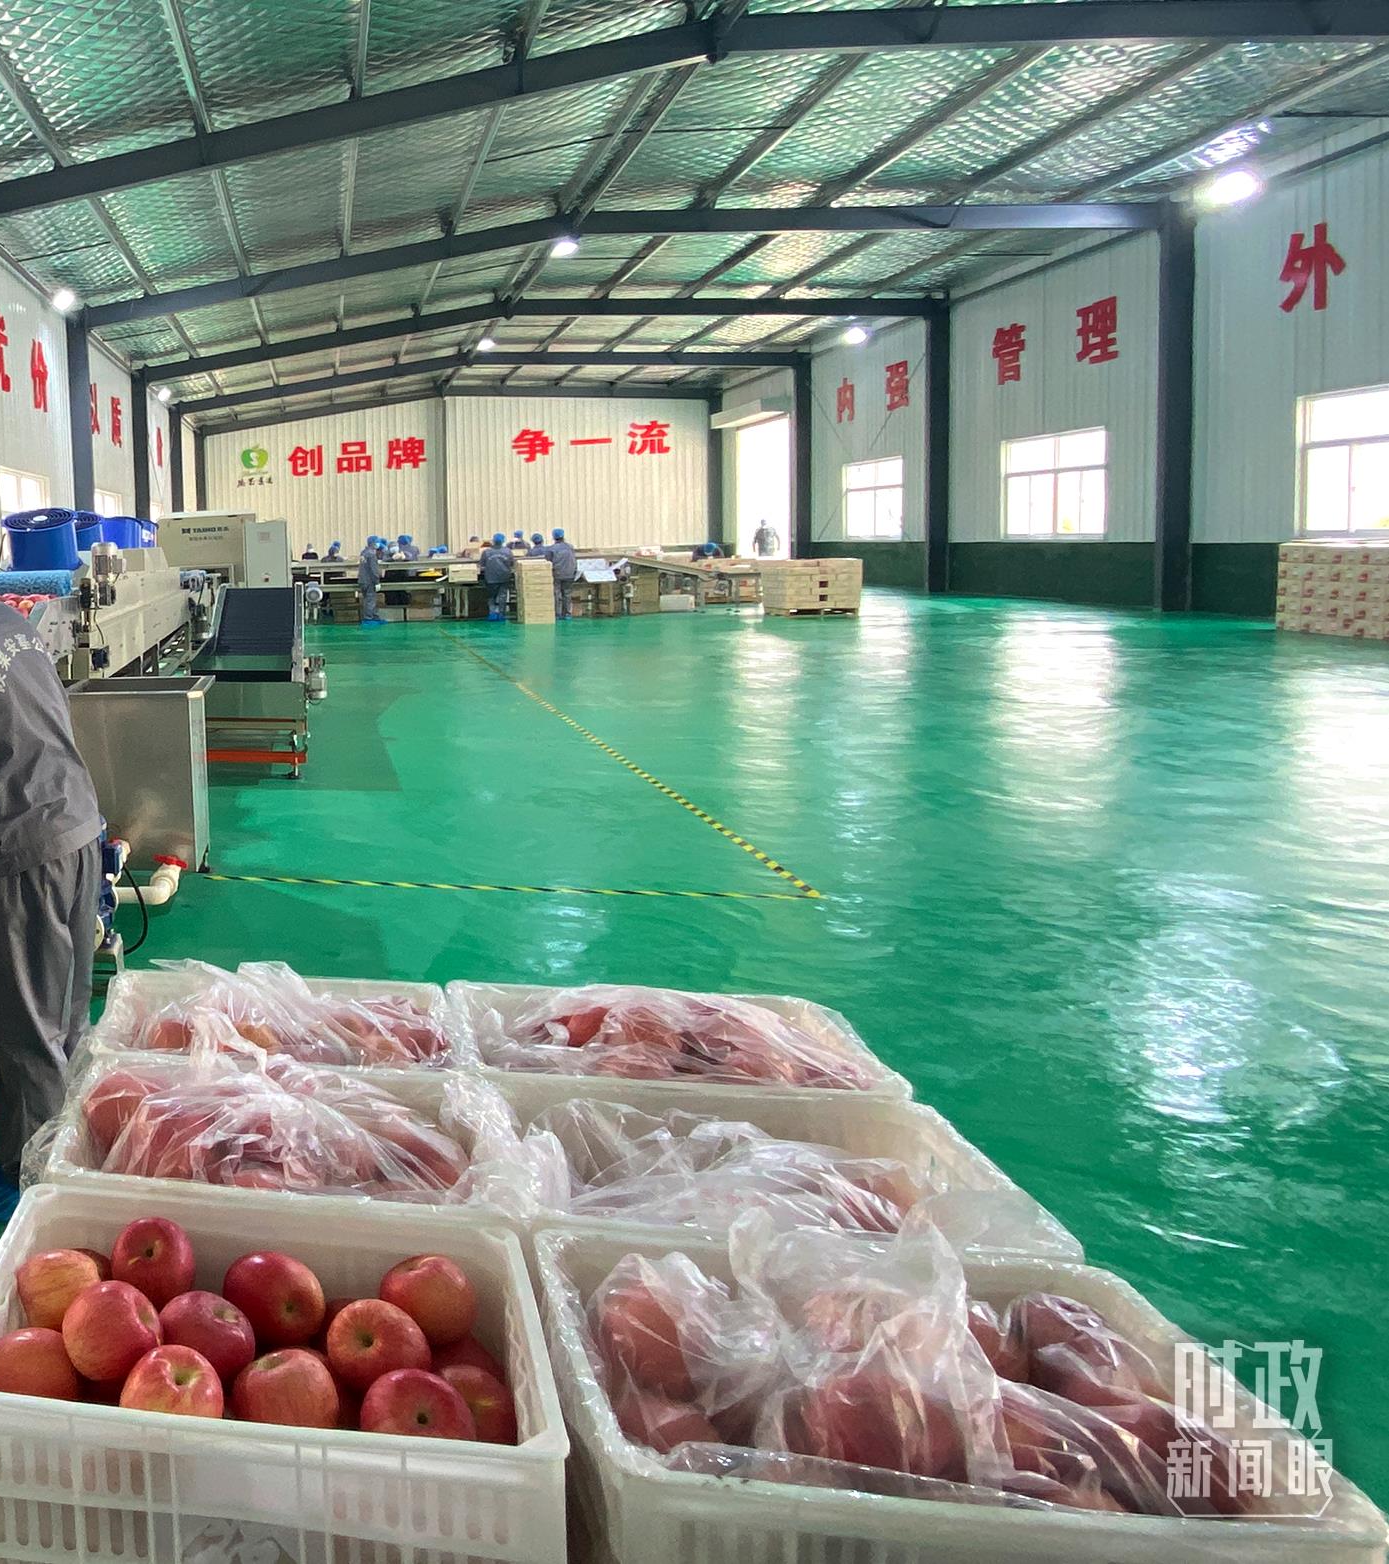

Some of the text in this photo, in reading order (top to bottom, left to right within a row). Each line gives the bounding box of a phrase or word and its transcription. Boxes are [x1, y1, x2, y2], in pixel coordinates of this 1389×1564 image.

[1280, 222, 1347, 313] 外
[836, 296, 1120, 423] 内强 管理
[287, 419, 672, 478] 创品牌 争一流
